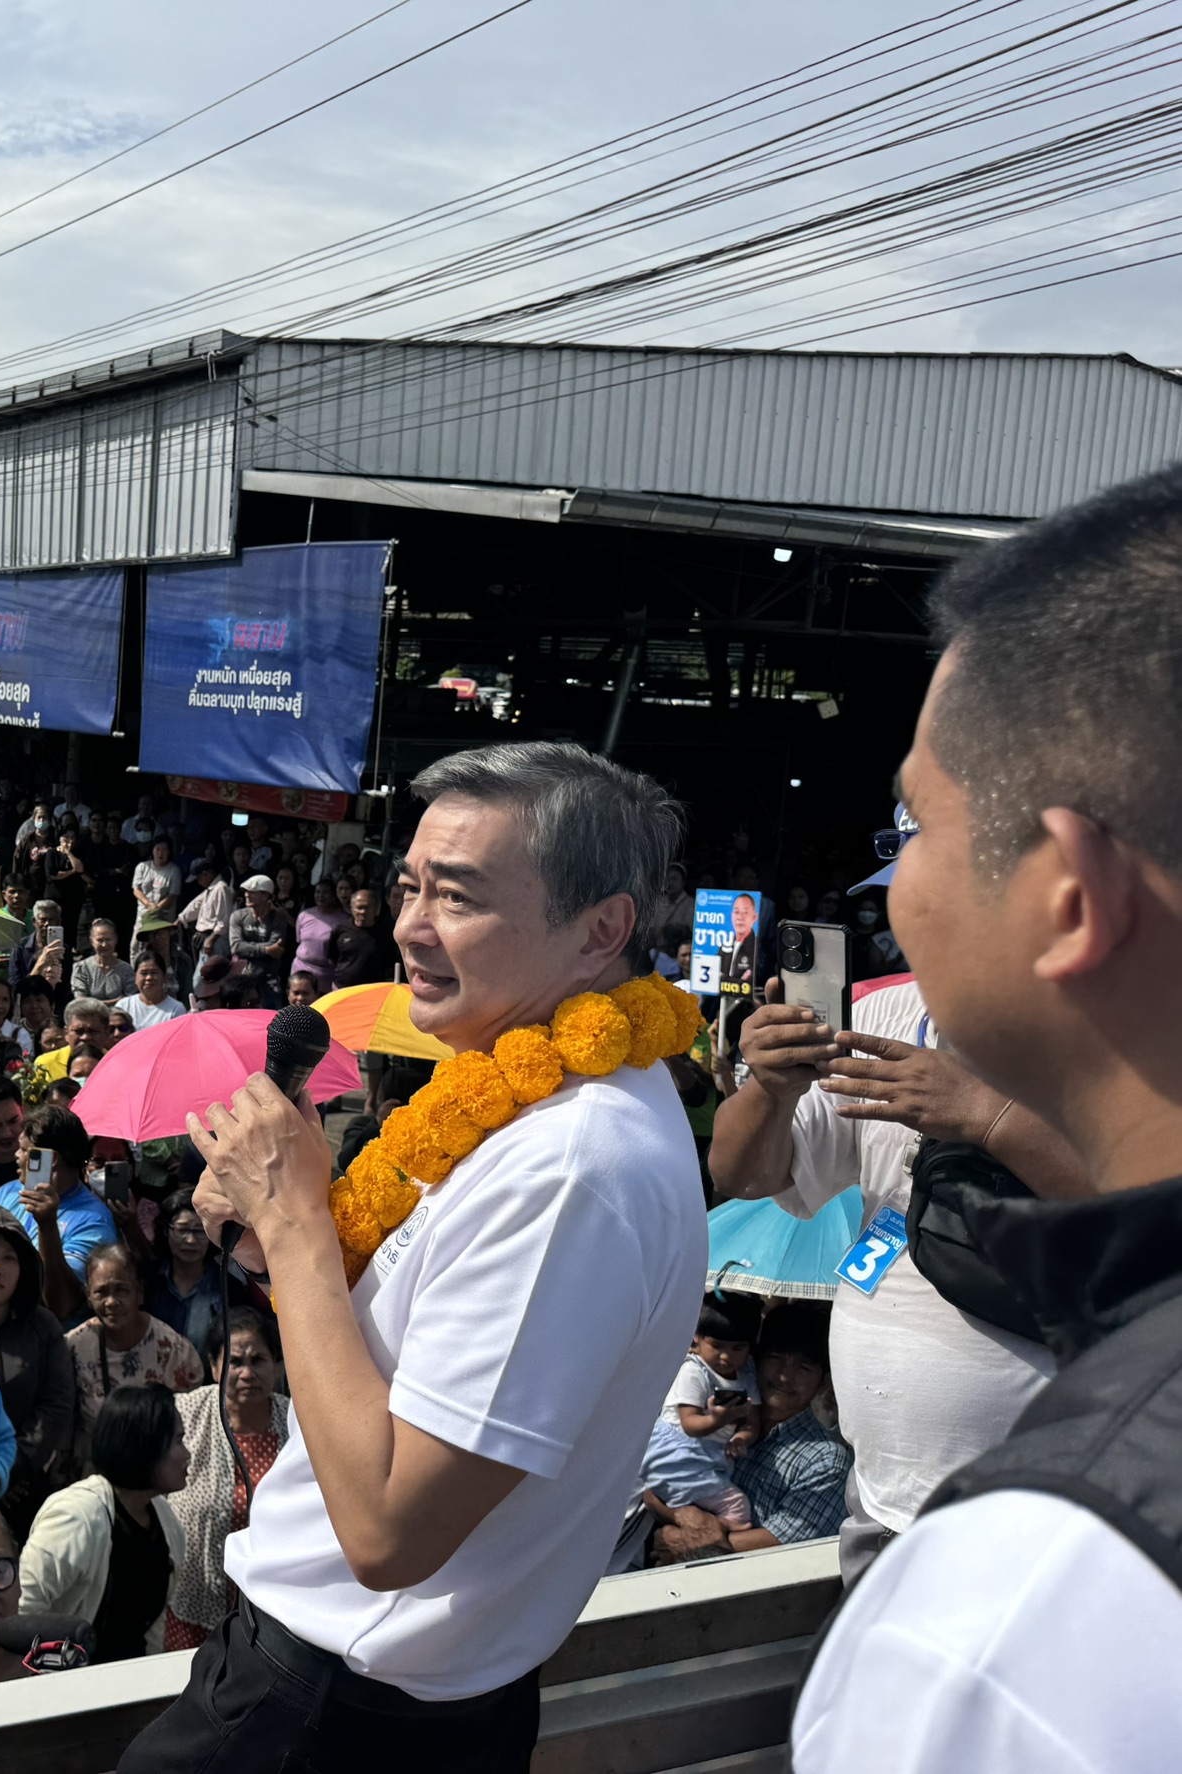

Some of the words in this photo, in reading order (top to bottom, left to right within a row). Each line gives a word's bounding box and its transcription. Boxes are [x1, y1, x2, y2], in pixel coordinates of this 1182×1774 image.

[195, 665, 237, 684] งานหนัก
[239, 659, 292, 692] เหนื่อยสุด
[188, 682, 245, 715] ดื่มฉลามบุก
[247, 690, 303, 719] ปลุกแรงสู้
[696, 910, 725, 924] นายก
[694, 928, 734, 954] ชาญ
[699, 965, 711, 983] 3
[741, 982, 751, 994] 9
[868, 1223, 904, 1251] นายกชาญ
[846, 1236, 891, 1282] 3
